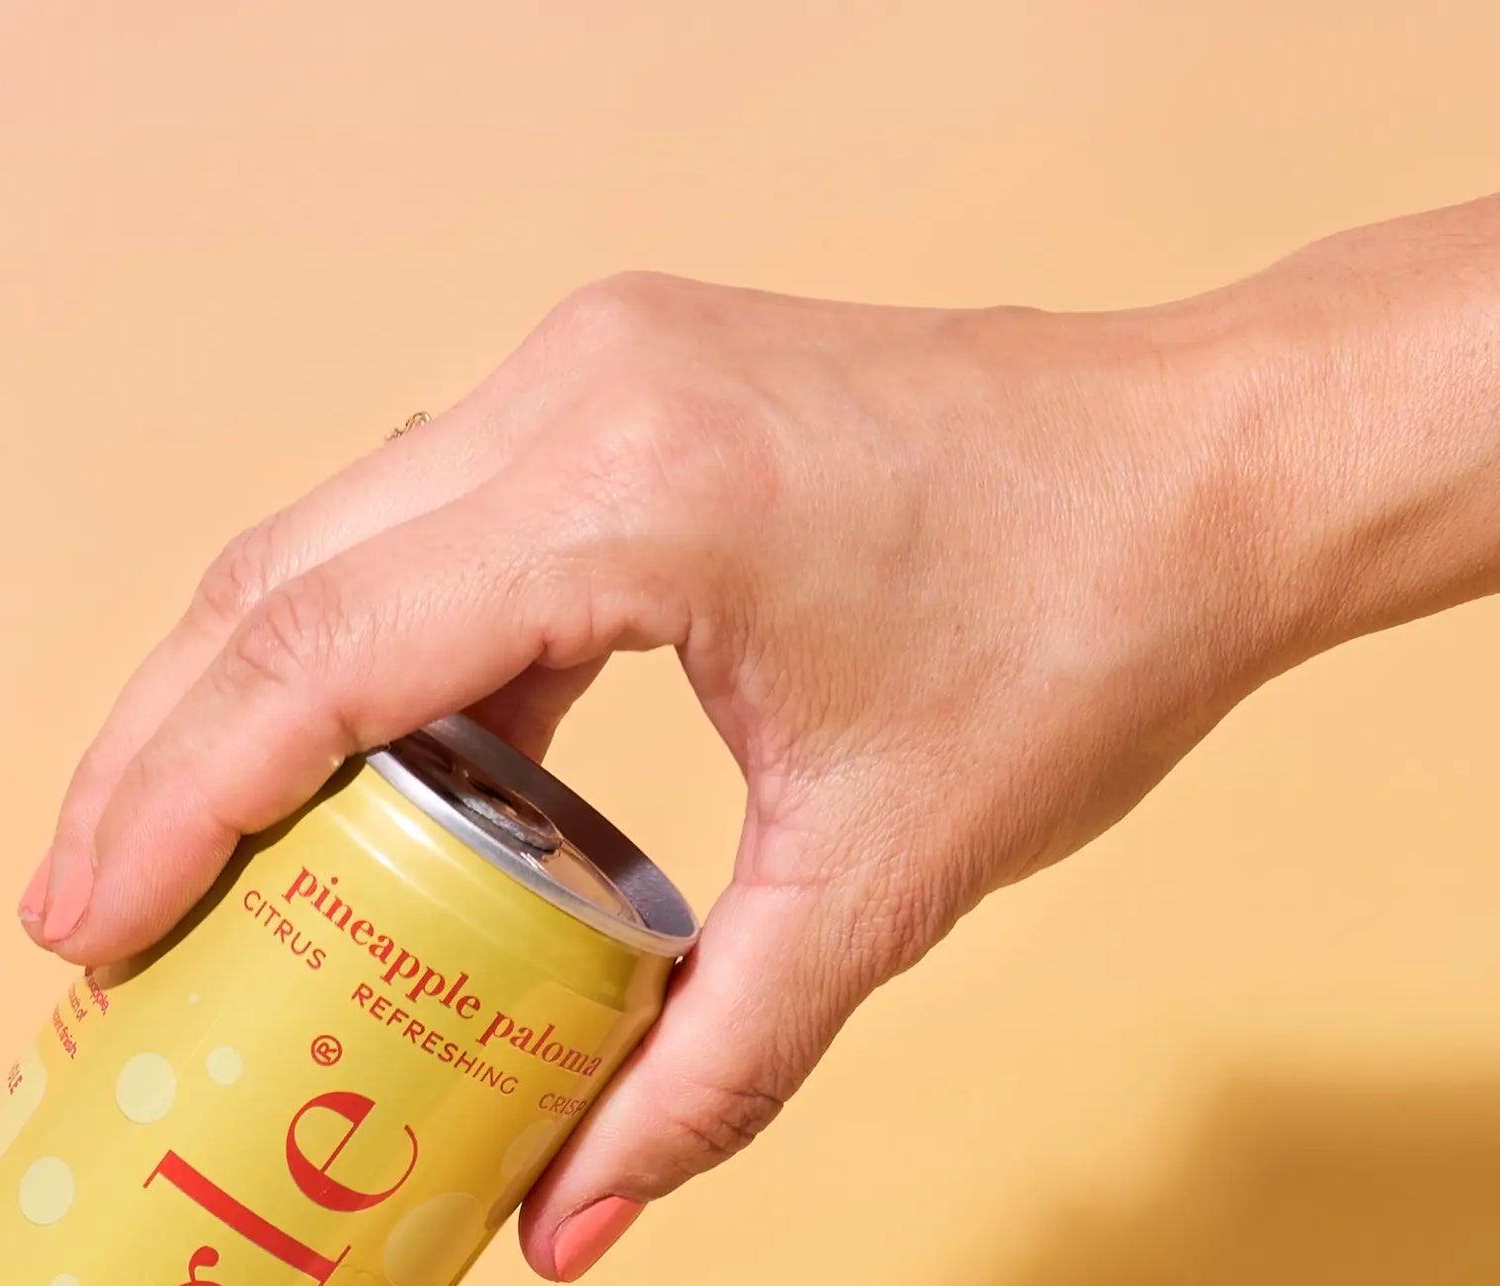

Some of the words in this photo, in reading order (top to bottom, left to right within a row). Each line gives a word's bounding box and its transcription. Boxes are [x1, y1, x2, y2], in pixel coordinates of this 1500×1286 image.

[242, 889, 327, 971] CITRUS
[351, 982, 519, 1096] REFRESHING
[282, 864, 481, 1020] pineapple
[475, 1006, 603, 1078] paloma
